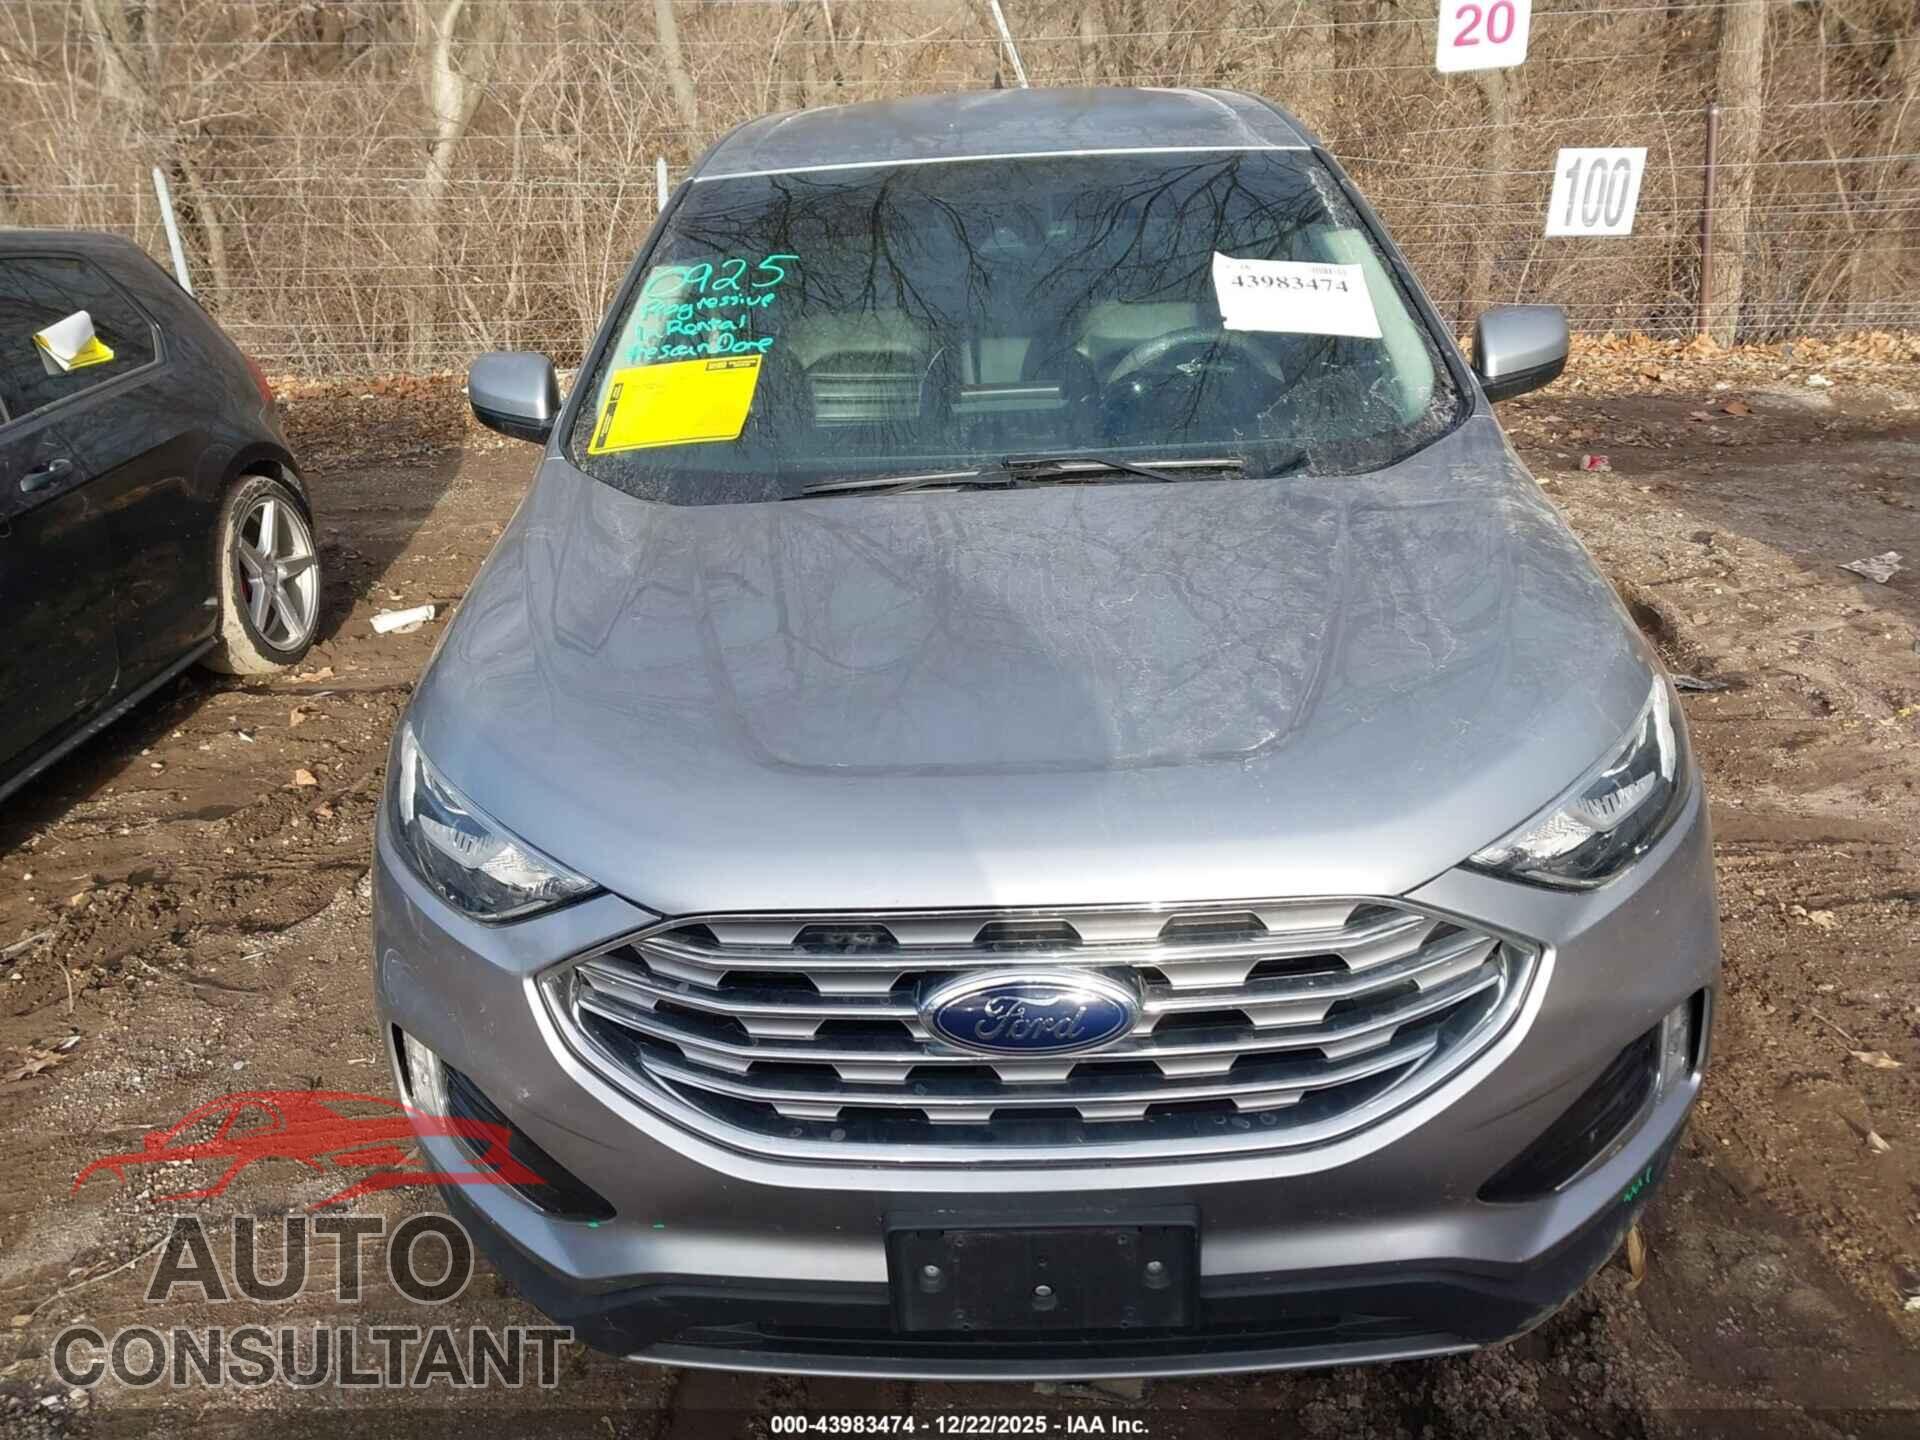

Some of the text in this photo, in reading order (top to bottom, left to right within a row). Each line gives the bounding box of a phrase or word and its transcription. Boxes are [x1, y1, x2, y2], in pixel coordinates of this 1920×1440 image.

[1453, 0, 1515, 46] 20
[1564, 157, 1632, 227] 100
[1231, 275, 1348, 293] 43983474
[974, 995, 1086, 1040] Ford
